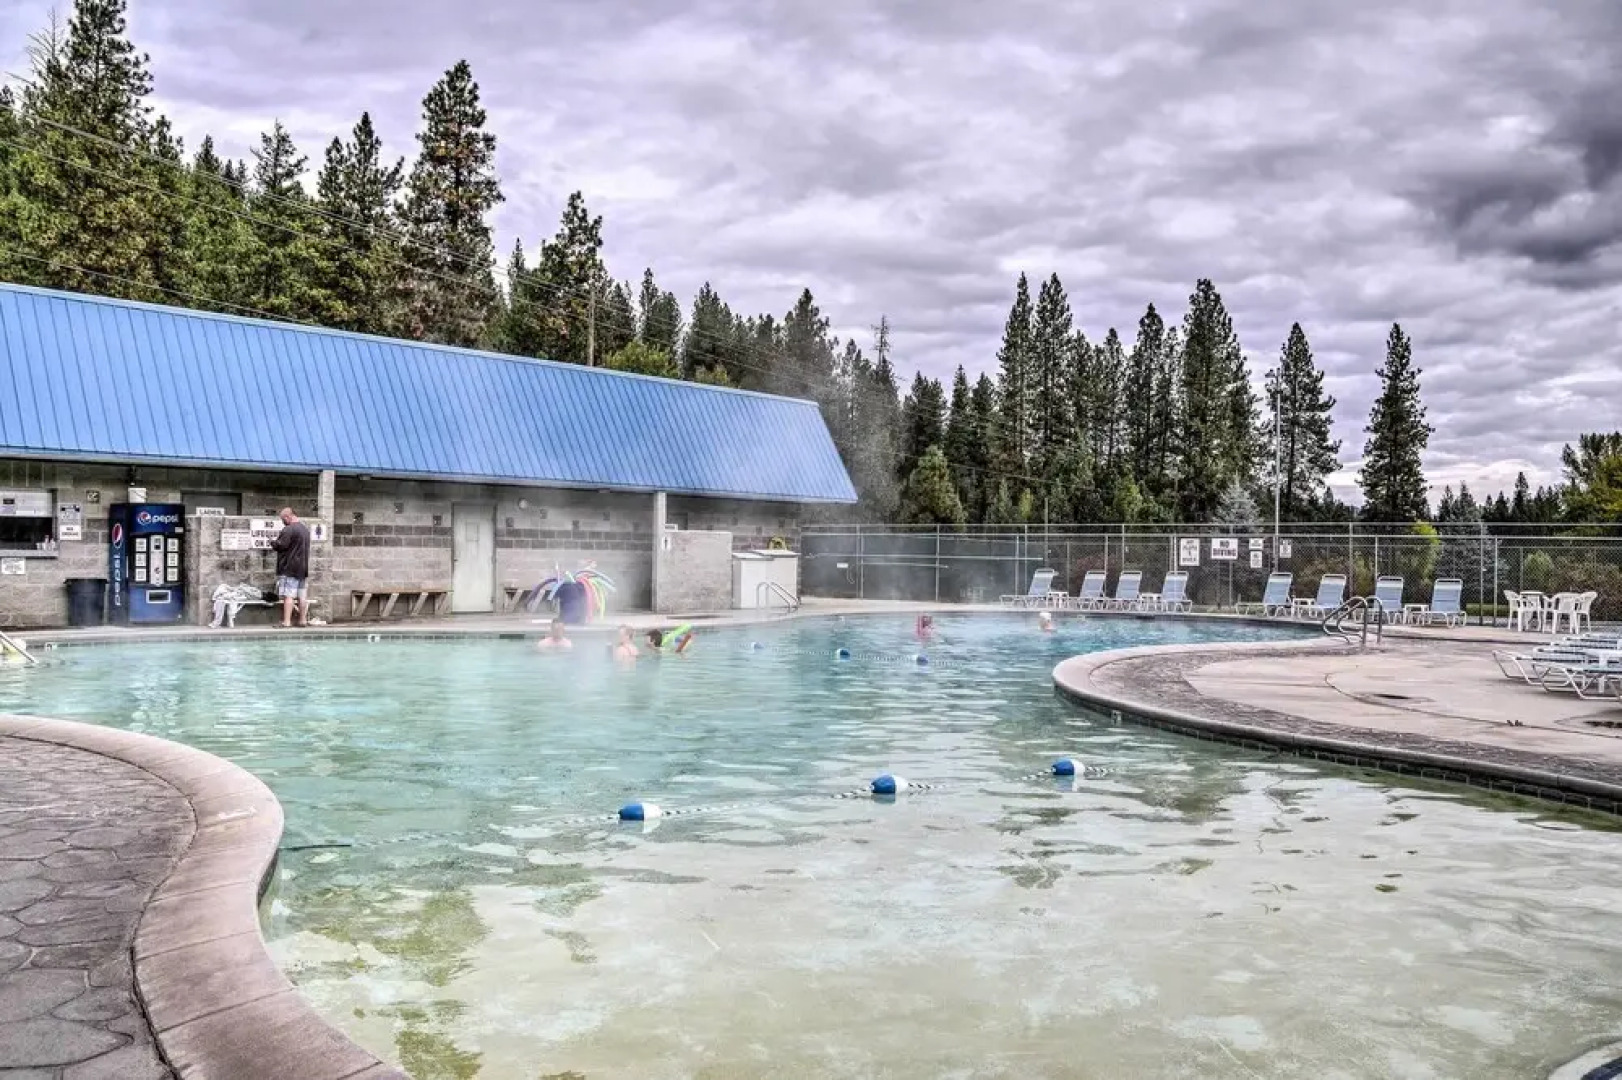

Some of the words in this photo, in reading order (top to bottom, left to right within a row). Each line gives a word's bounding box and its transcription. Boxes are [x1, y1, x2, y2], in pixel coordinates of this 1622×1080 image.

[152, 513, 179, 524] pepsi
[1220, 540, 1230, 548] NO
[1212, 548, 1237, 557] DIVING
